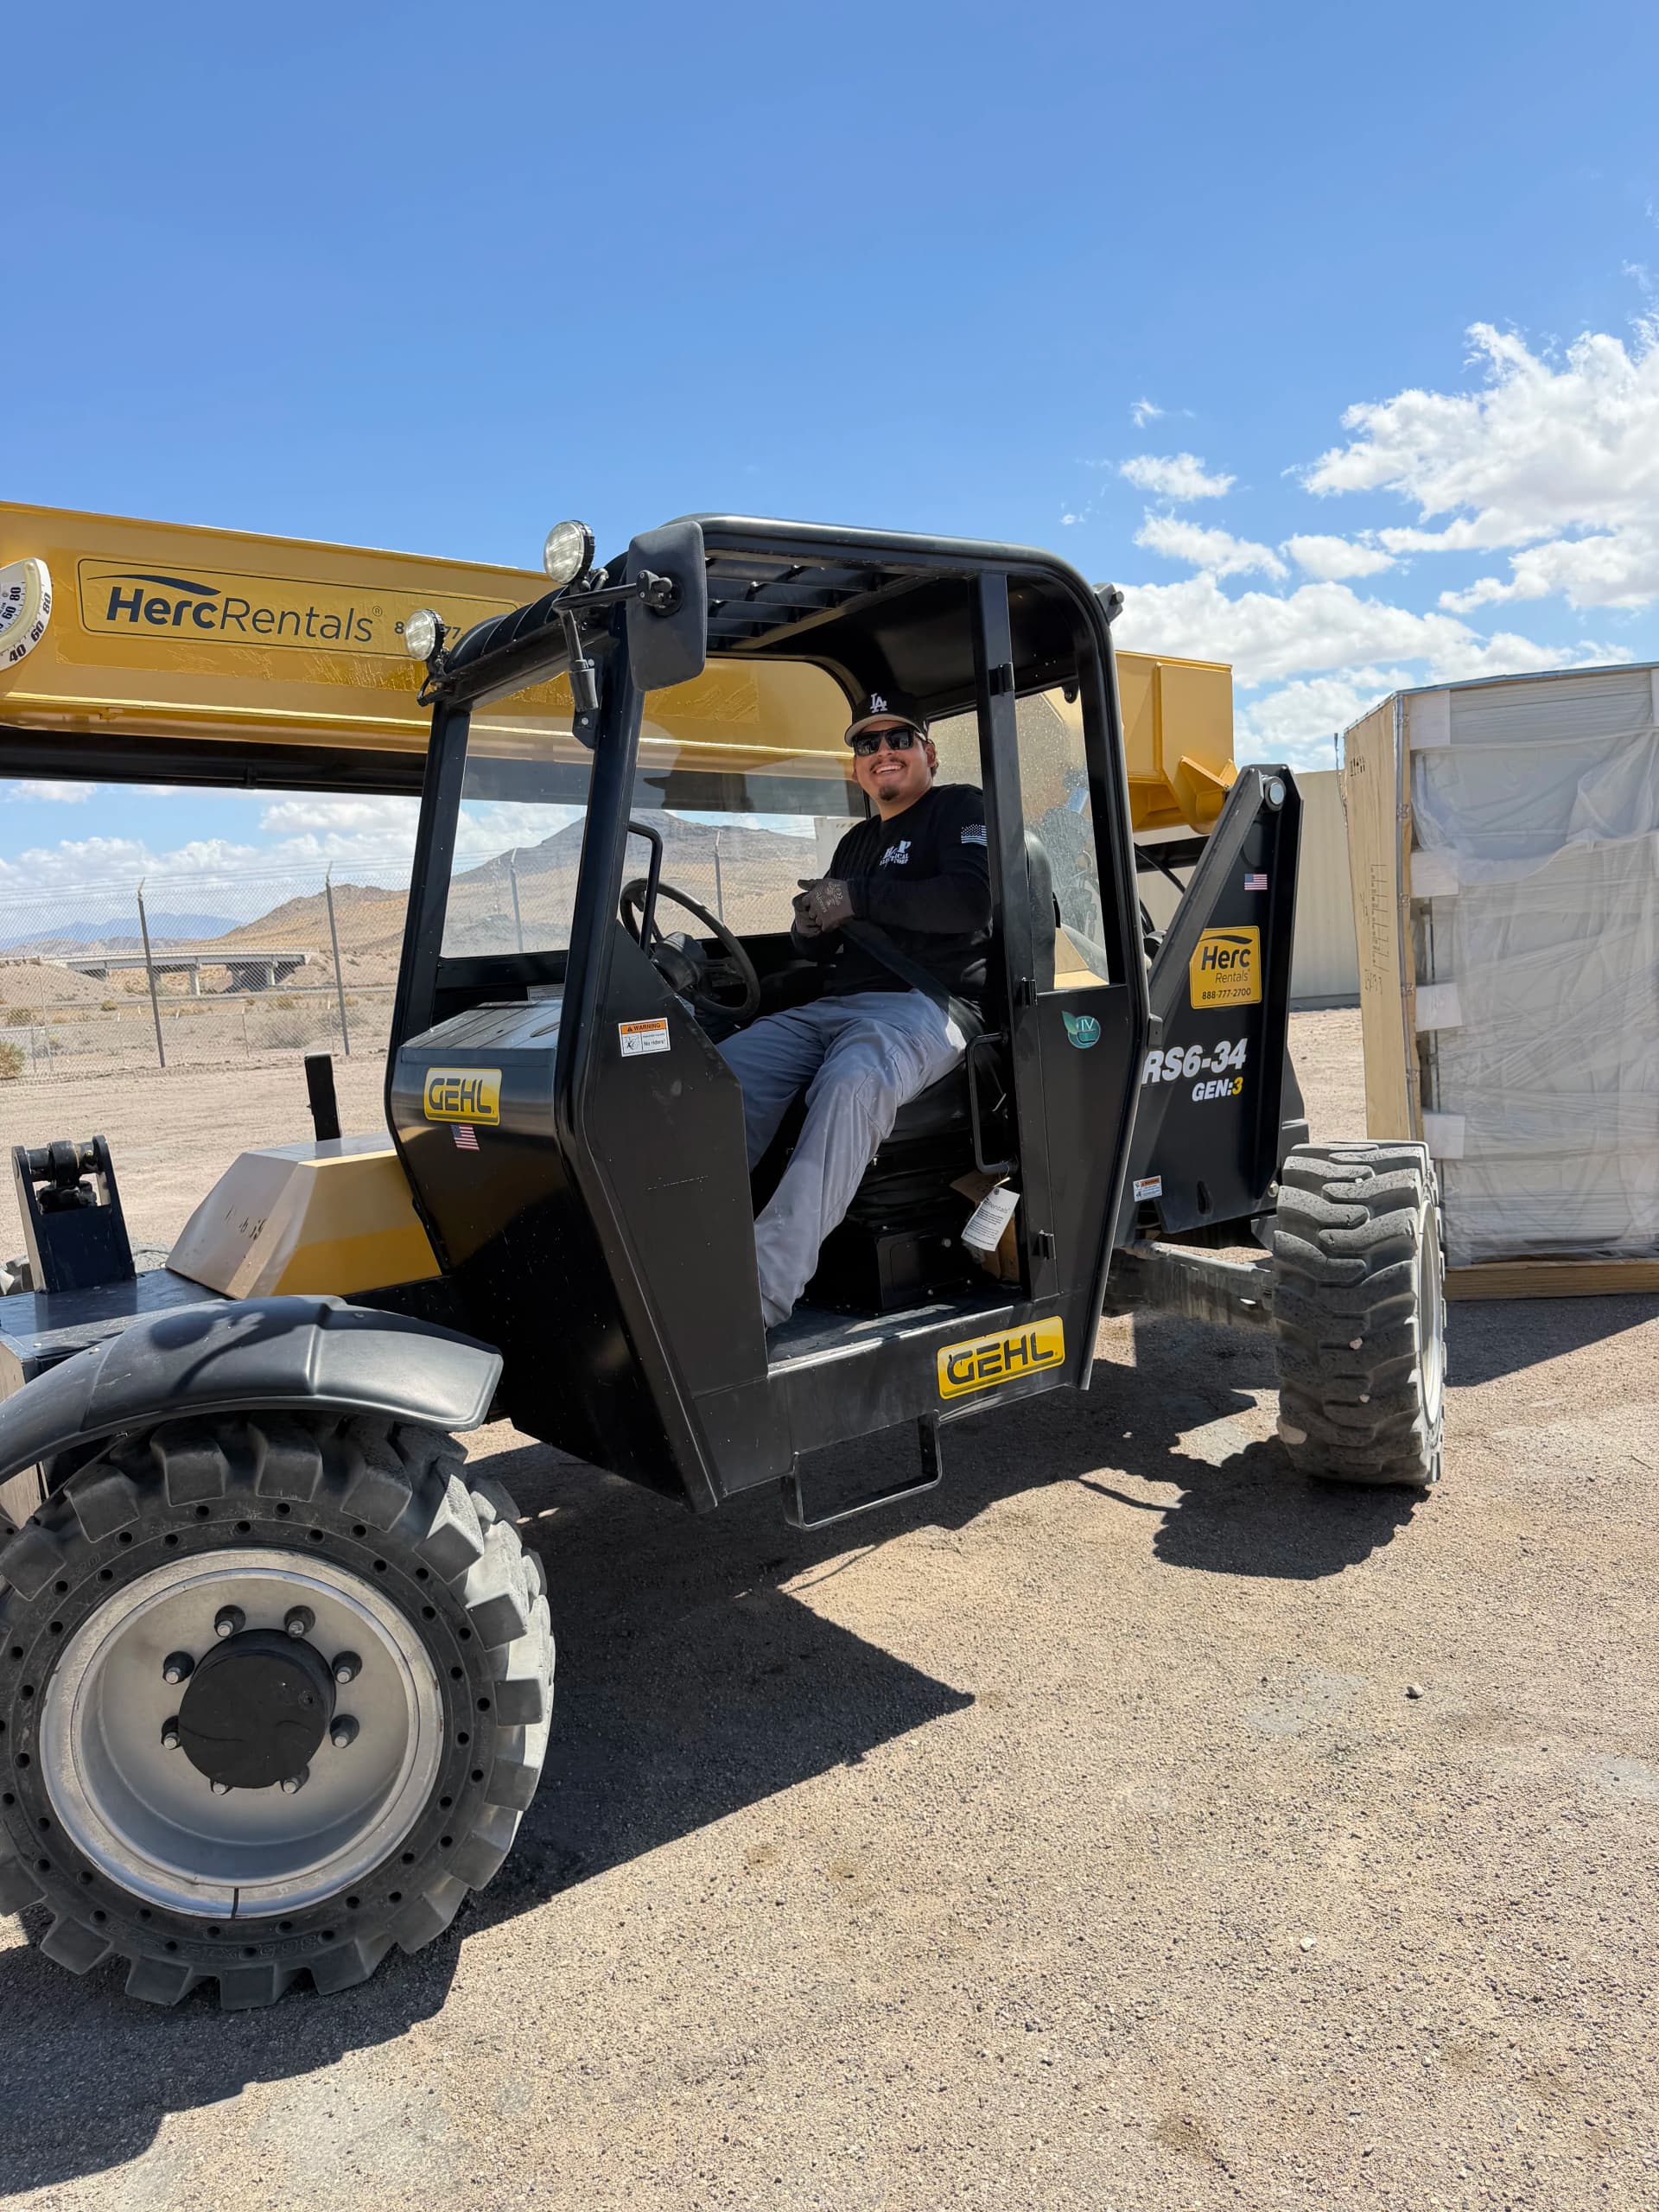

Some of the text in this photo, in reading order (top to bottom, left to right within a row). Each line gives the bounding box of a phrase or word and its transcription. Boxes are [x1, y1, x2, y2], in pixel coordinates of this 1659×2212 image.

[9, 587, 22, 601] 80
[42, 592, 52, 614] 80
[1, 606, 16, 620] 60
[30, 620, 45, 642] 60
[9, 644, 27, 663] 40
[870, 692, 888, 714] LA
[1201, 945, 1251, 970] Herc
[1215, 970, 1249, 983] Rentals
[1202, 988, 1251, 1000] 888-777-2700
[633, 1022, 661, 1031] WARNING
[1141, 1038, 1248, 1084] RS6-34
[429, 1078, 492, 1114] GEHL
[1192, 1077, 1243, 1102] GEN:3
[947, 1332, 1053, 1384] GEHL
